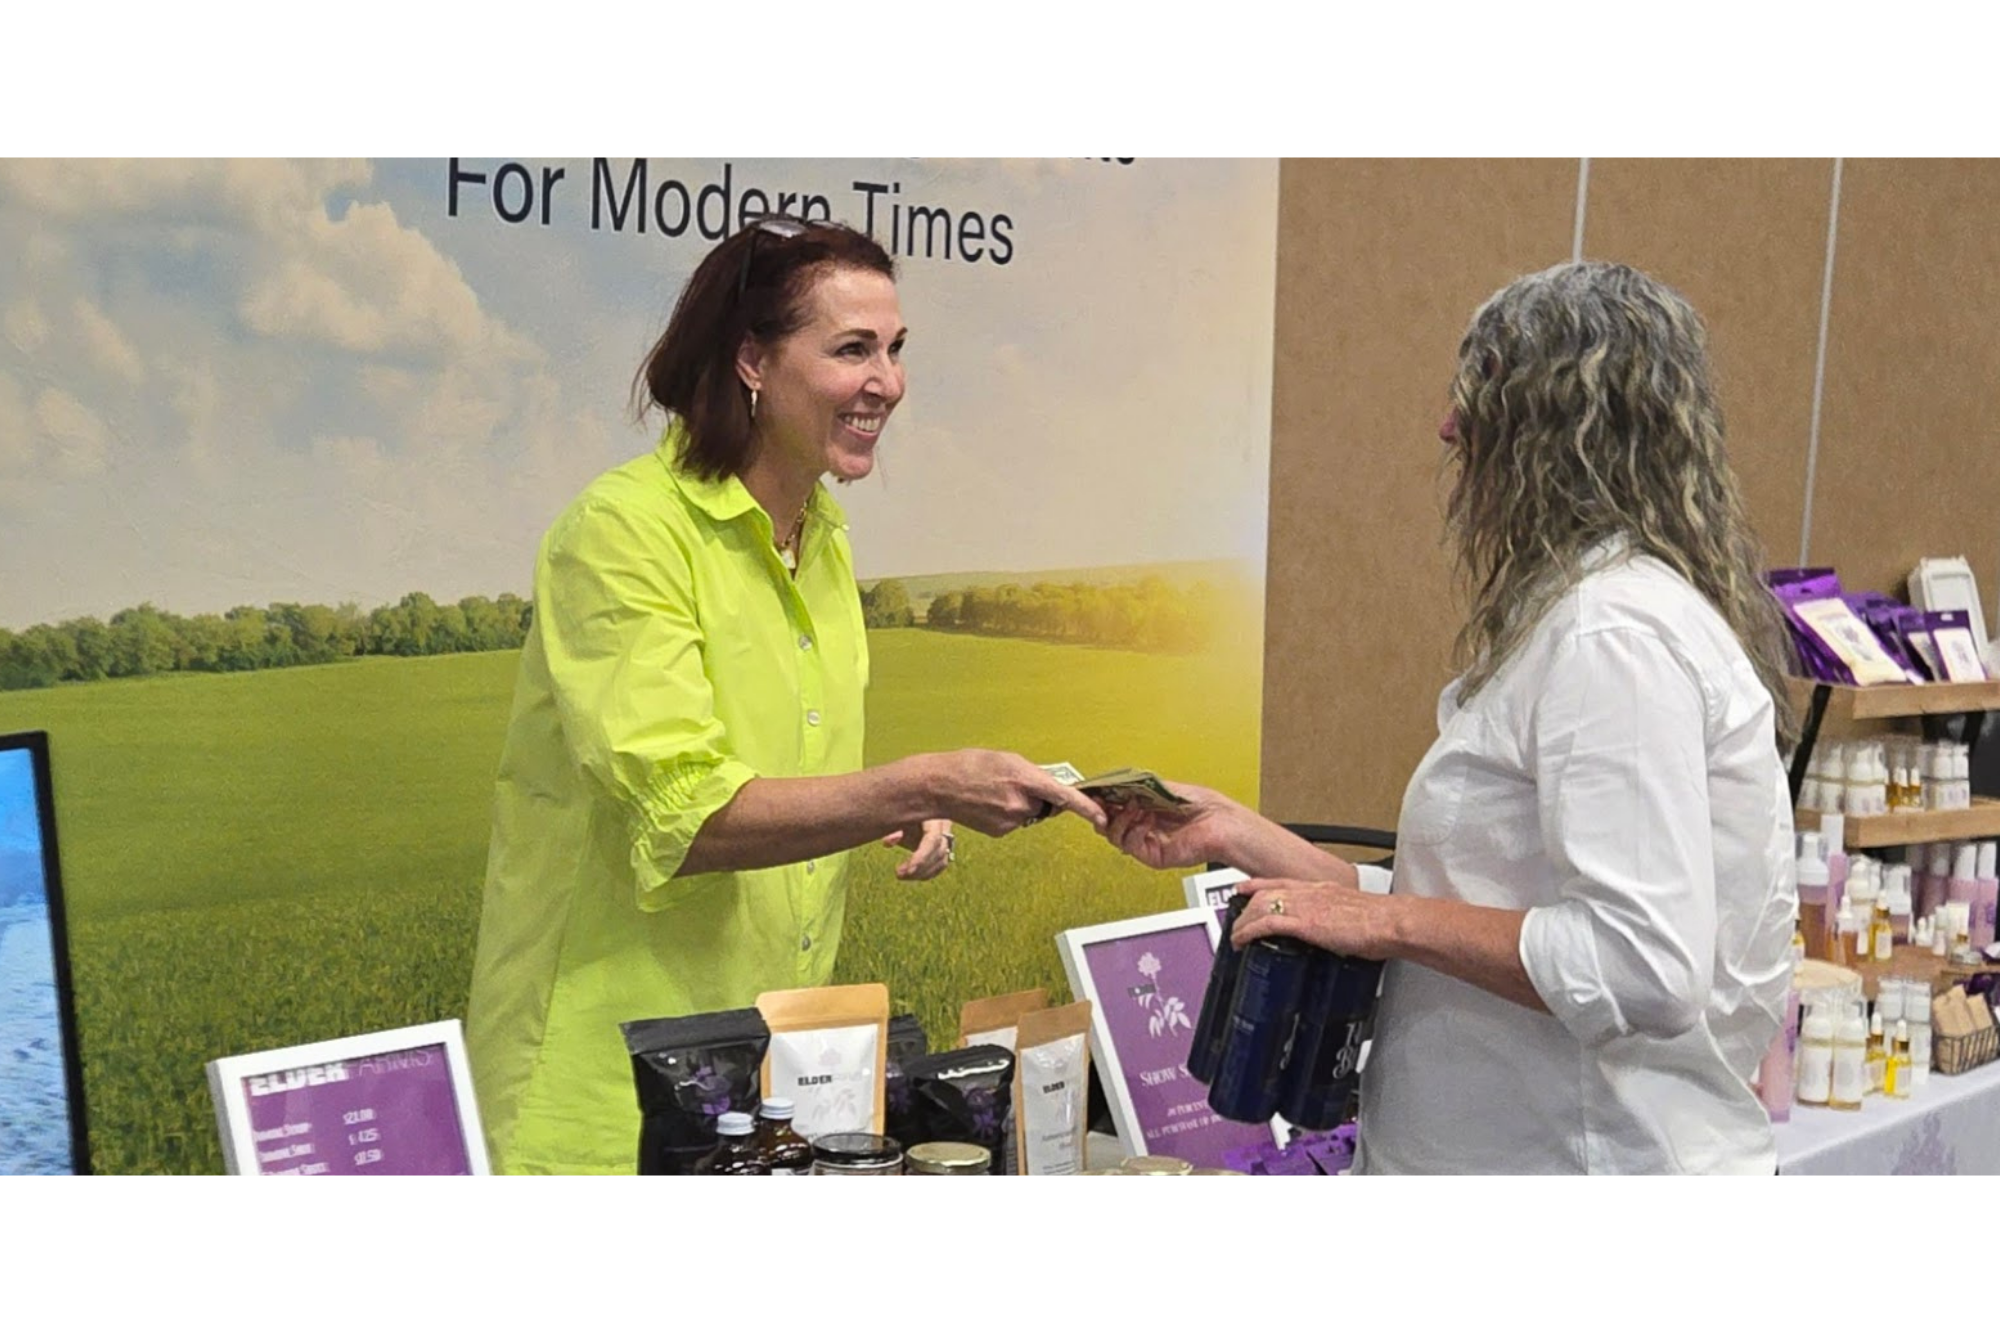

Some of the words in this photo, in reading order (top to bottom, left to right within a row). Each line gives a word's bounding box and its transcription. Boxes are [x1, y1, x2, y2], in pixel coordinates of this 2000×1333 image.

[447, 157, 565, 226] For
[852, 181, 1014, 265] Times
[798, 1075, 832, 1086] ELDER
